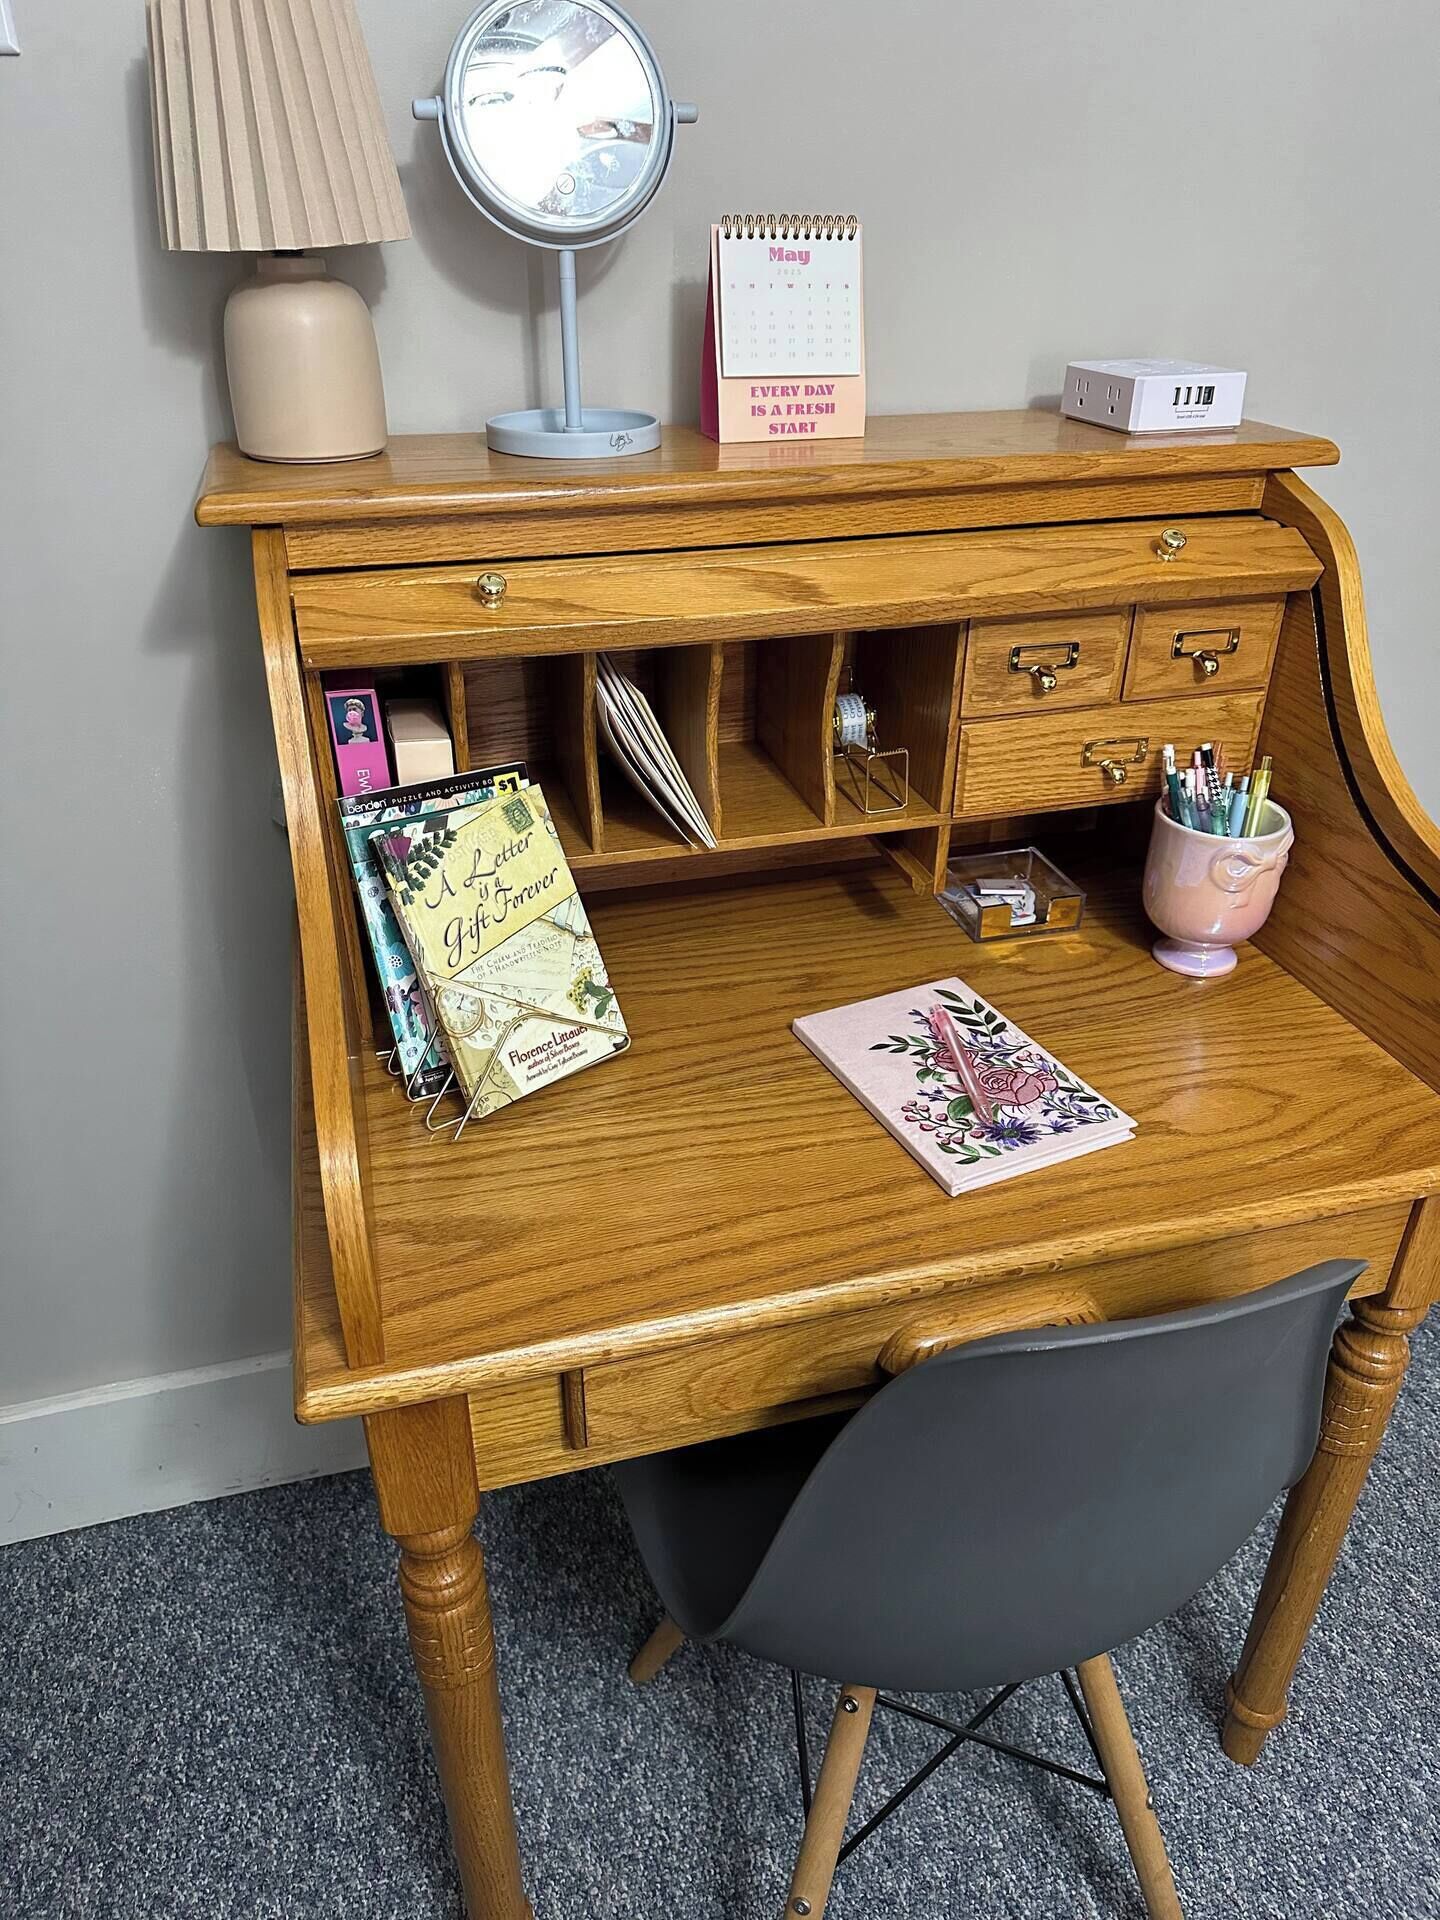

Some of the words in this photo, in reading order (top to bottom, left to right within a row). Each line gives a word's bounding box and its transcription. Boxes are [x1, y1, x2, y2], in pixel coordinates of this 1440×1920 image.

[769, 247, 811, 265] May
[751, 386, 800, 398] EVERY
[804, 384, 835, 396] DAY
[751, 404, 766, 417] IS
[770, 404, 782, 416] A
[786, 403, 835, 416] FRESH
[768, 422, 818, 435] START
[498, 776, 518, 792] $1
[347, 800, 387, 814] bendon
[392, 793, 422, 804] PUZZLE
[426, 789, 442, 798] AND
[444, 781, 480, 794] ACTIVITY
[483, 778, 493, 786] BO
[424, 870, 456, 908] A
[463, 832, 533, 888] Letter
[479, 882, 489, 901] is
[495, 877, 503, 888] a
[444, 903, 490, 968] Gift
[493, 867, 558, 922] Forever
[471, 965, 484, 974] THE
[513, 947, 526, 957] AND
[477, 972, 486, 980] OF
[508, 1040, 554, 1066] Florence
[527, 1058, 545, 1070] author
[545, 1053, 551, 1062] of
